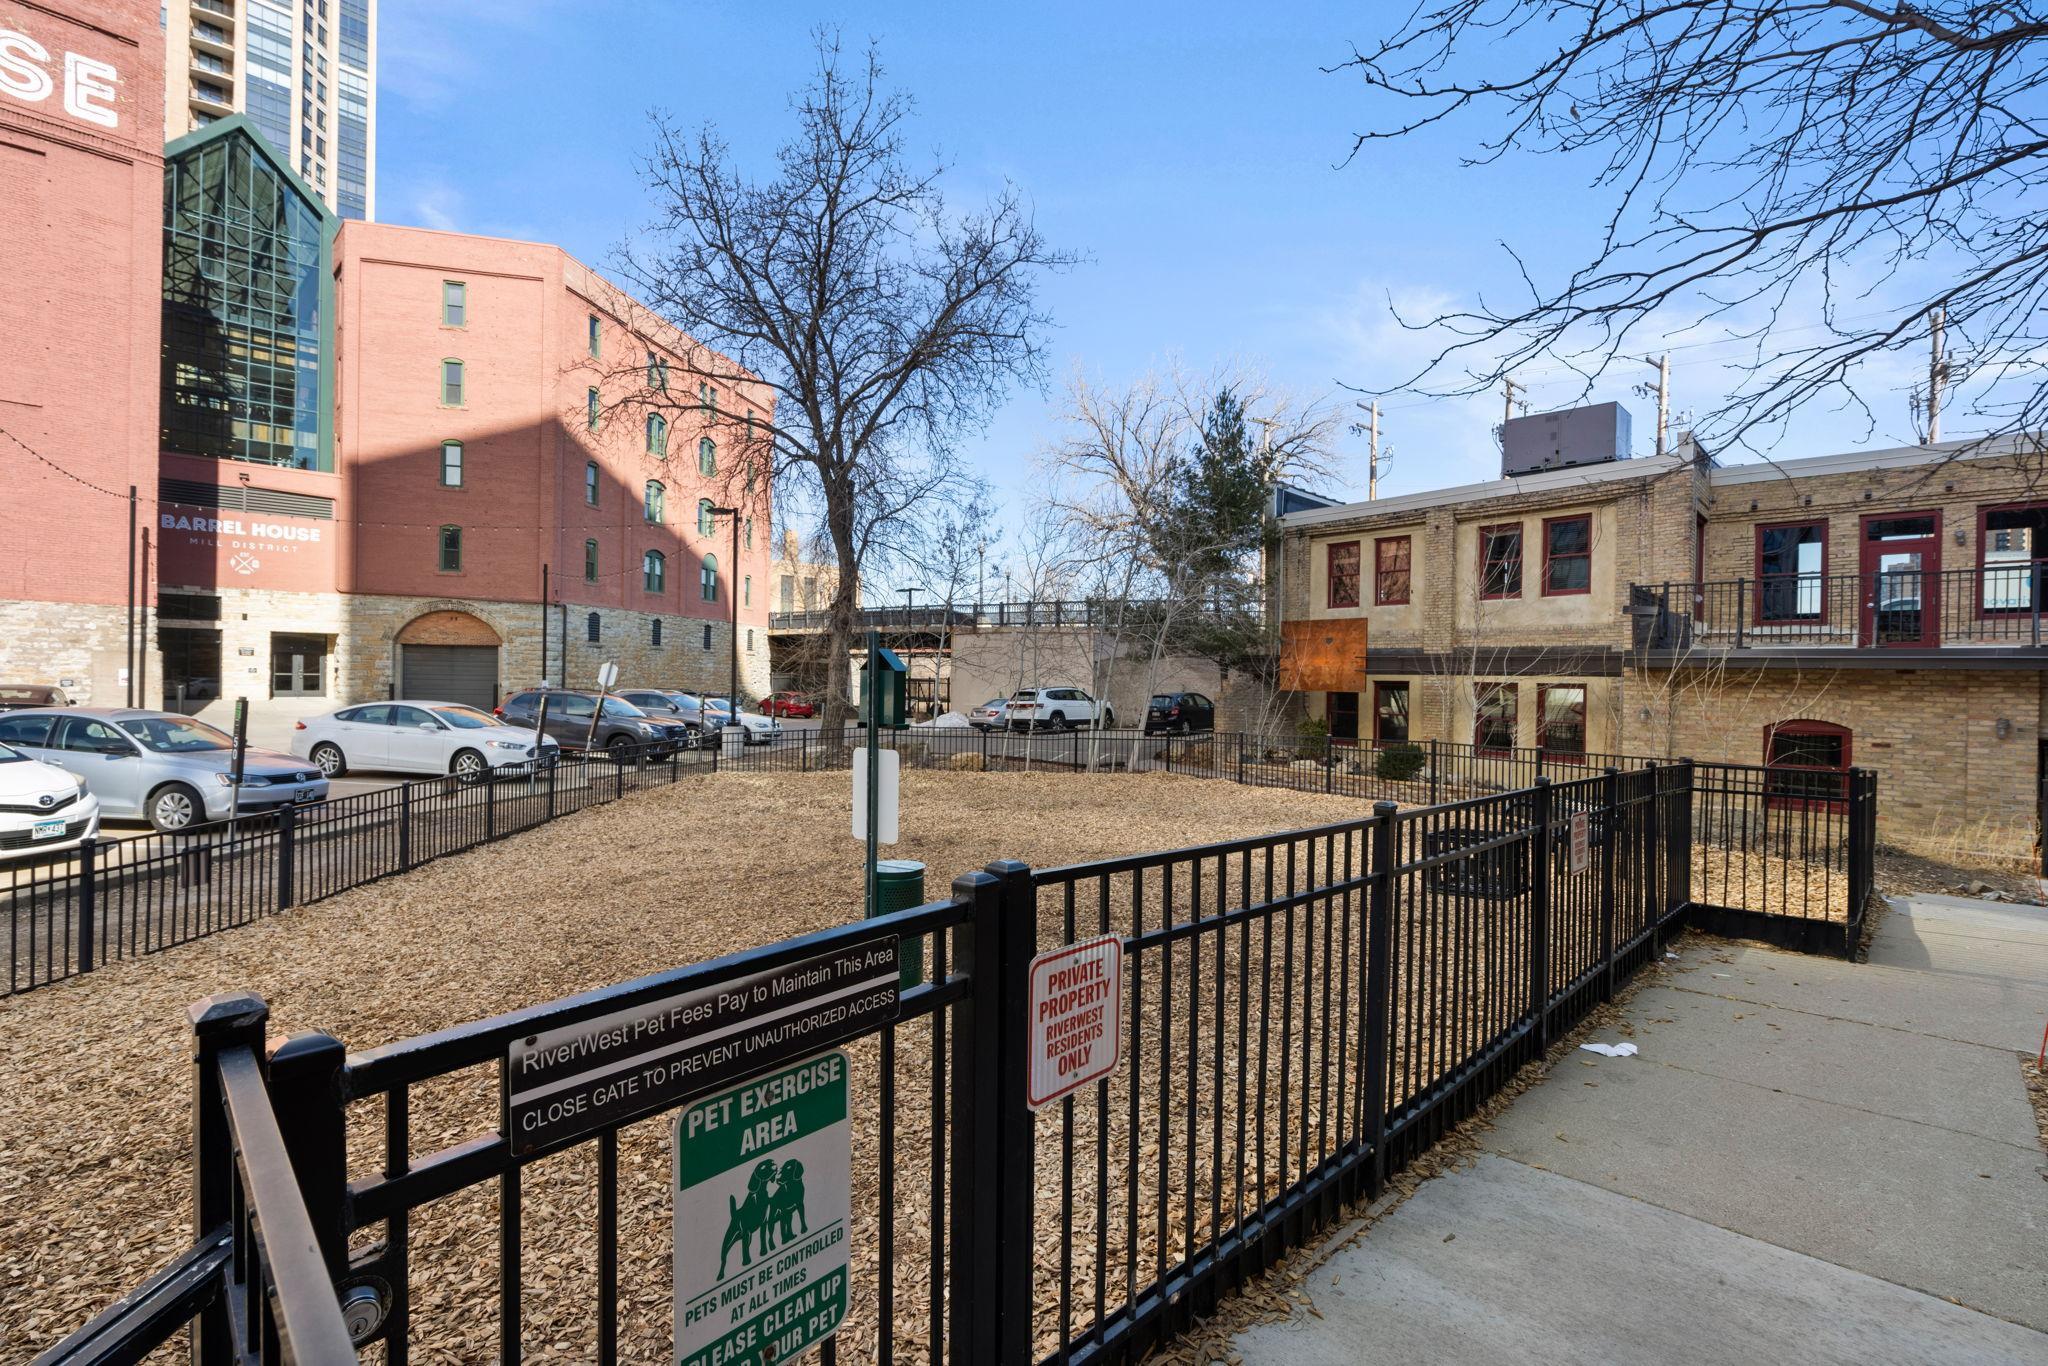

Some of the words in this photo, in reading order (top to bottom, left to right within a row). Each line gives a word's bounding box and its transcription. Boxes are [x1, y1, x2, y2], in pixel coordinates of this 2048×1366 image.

[161, 514, 247, 535] BARREL
[251, 523, 321, 542] HOUSE
[189, 537, 223, 547] MILL
[232, 541, 298, 553] DISTRICT
[1048, 958, 1104, 995] PRIVATE
[522, 1028, 629, 1074] RiverWest
[634, 1012, 665, 1039] Pet
[671, 1004, 713, 1029] Fees
[718, 991, 749, 1014] Pay
[753, 985, 768, 1003] to
[772, 965, 831, 998] Maintain
[834, 956, 862, 977] This
[864, 948, 893, 968] Area
[1039, 978, 1111, 1023] PROPERTY
[1046, 1005, 1104, 1041] RIVERWEST
[522, 1093, 588, 1132] CLOSE
[593, 1076, 639, 1107] GATE
[643, 1067, 666, 1089] TO
[670, 1040, 742, 1080] PREVENT
[745, 1006, 846, 1053] UNAUTHORIZED
[848, 989, 895, 1017] ACCESS
[1046, 1023, 1103, 1060] RESIDENTS
[1058, 1044, 1092, 1077] ONLY
[688, 1097, 733, 1139] PET
[741, 1057, 841, 1120] EXERCISE
[739, 1110, 798, 1157] AREA
[685, 1297, 717, 1328] PETS
[721, 1275, 755, 1309] MUST
[758, 1266, 773, 1285] BE
[776, 1227, 844, 1276] CONTROLLED
[730, 1303, 745, 1325] AT
[749, 1290, 769, 1314] ALL
[772, 1268, 807, 1300] TIMES
[763, 1288, 815, 1336] CLEAN
[821, 1275, 841, 1299] UP
[808, 1304, 838, 1338] PET
